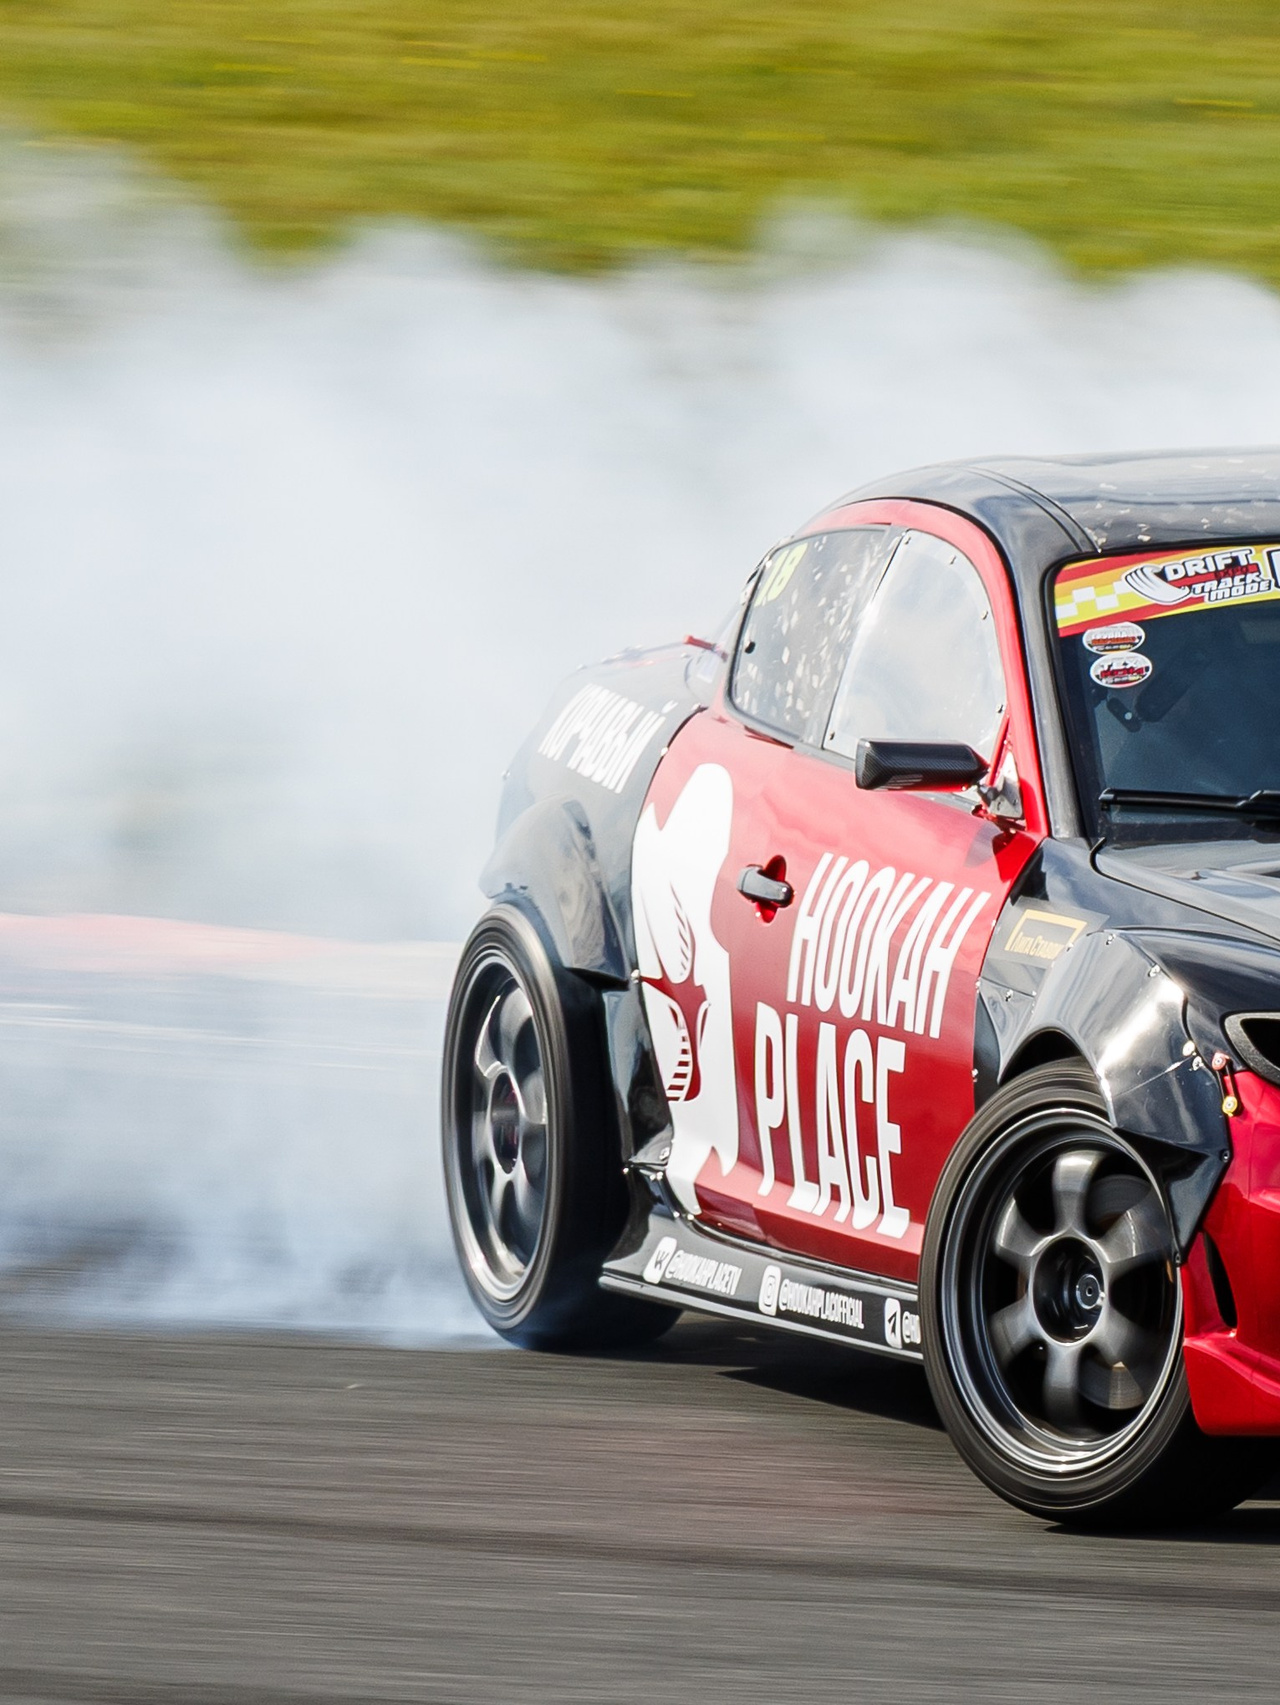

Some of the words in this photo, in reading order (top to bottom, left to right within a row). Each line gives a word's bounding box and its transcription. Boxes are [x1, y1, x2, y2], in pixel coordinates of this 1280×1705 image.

[1164, 549, 1253, 582] DRIFT
[1192, 572, 1263, 595] TRACK
[1209, 580, 1271, 602] MODE
[537, 682, 679, 795] КОРЧАВЫЙ
[787, 852, 992, 1039] HOOKAH
[755, 1001, 910, 1239] PLACE
